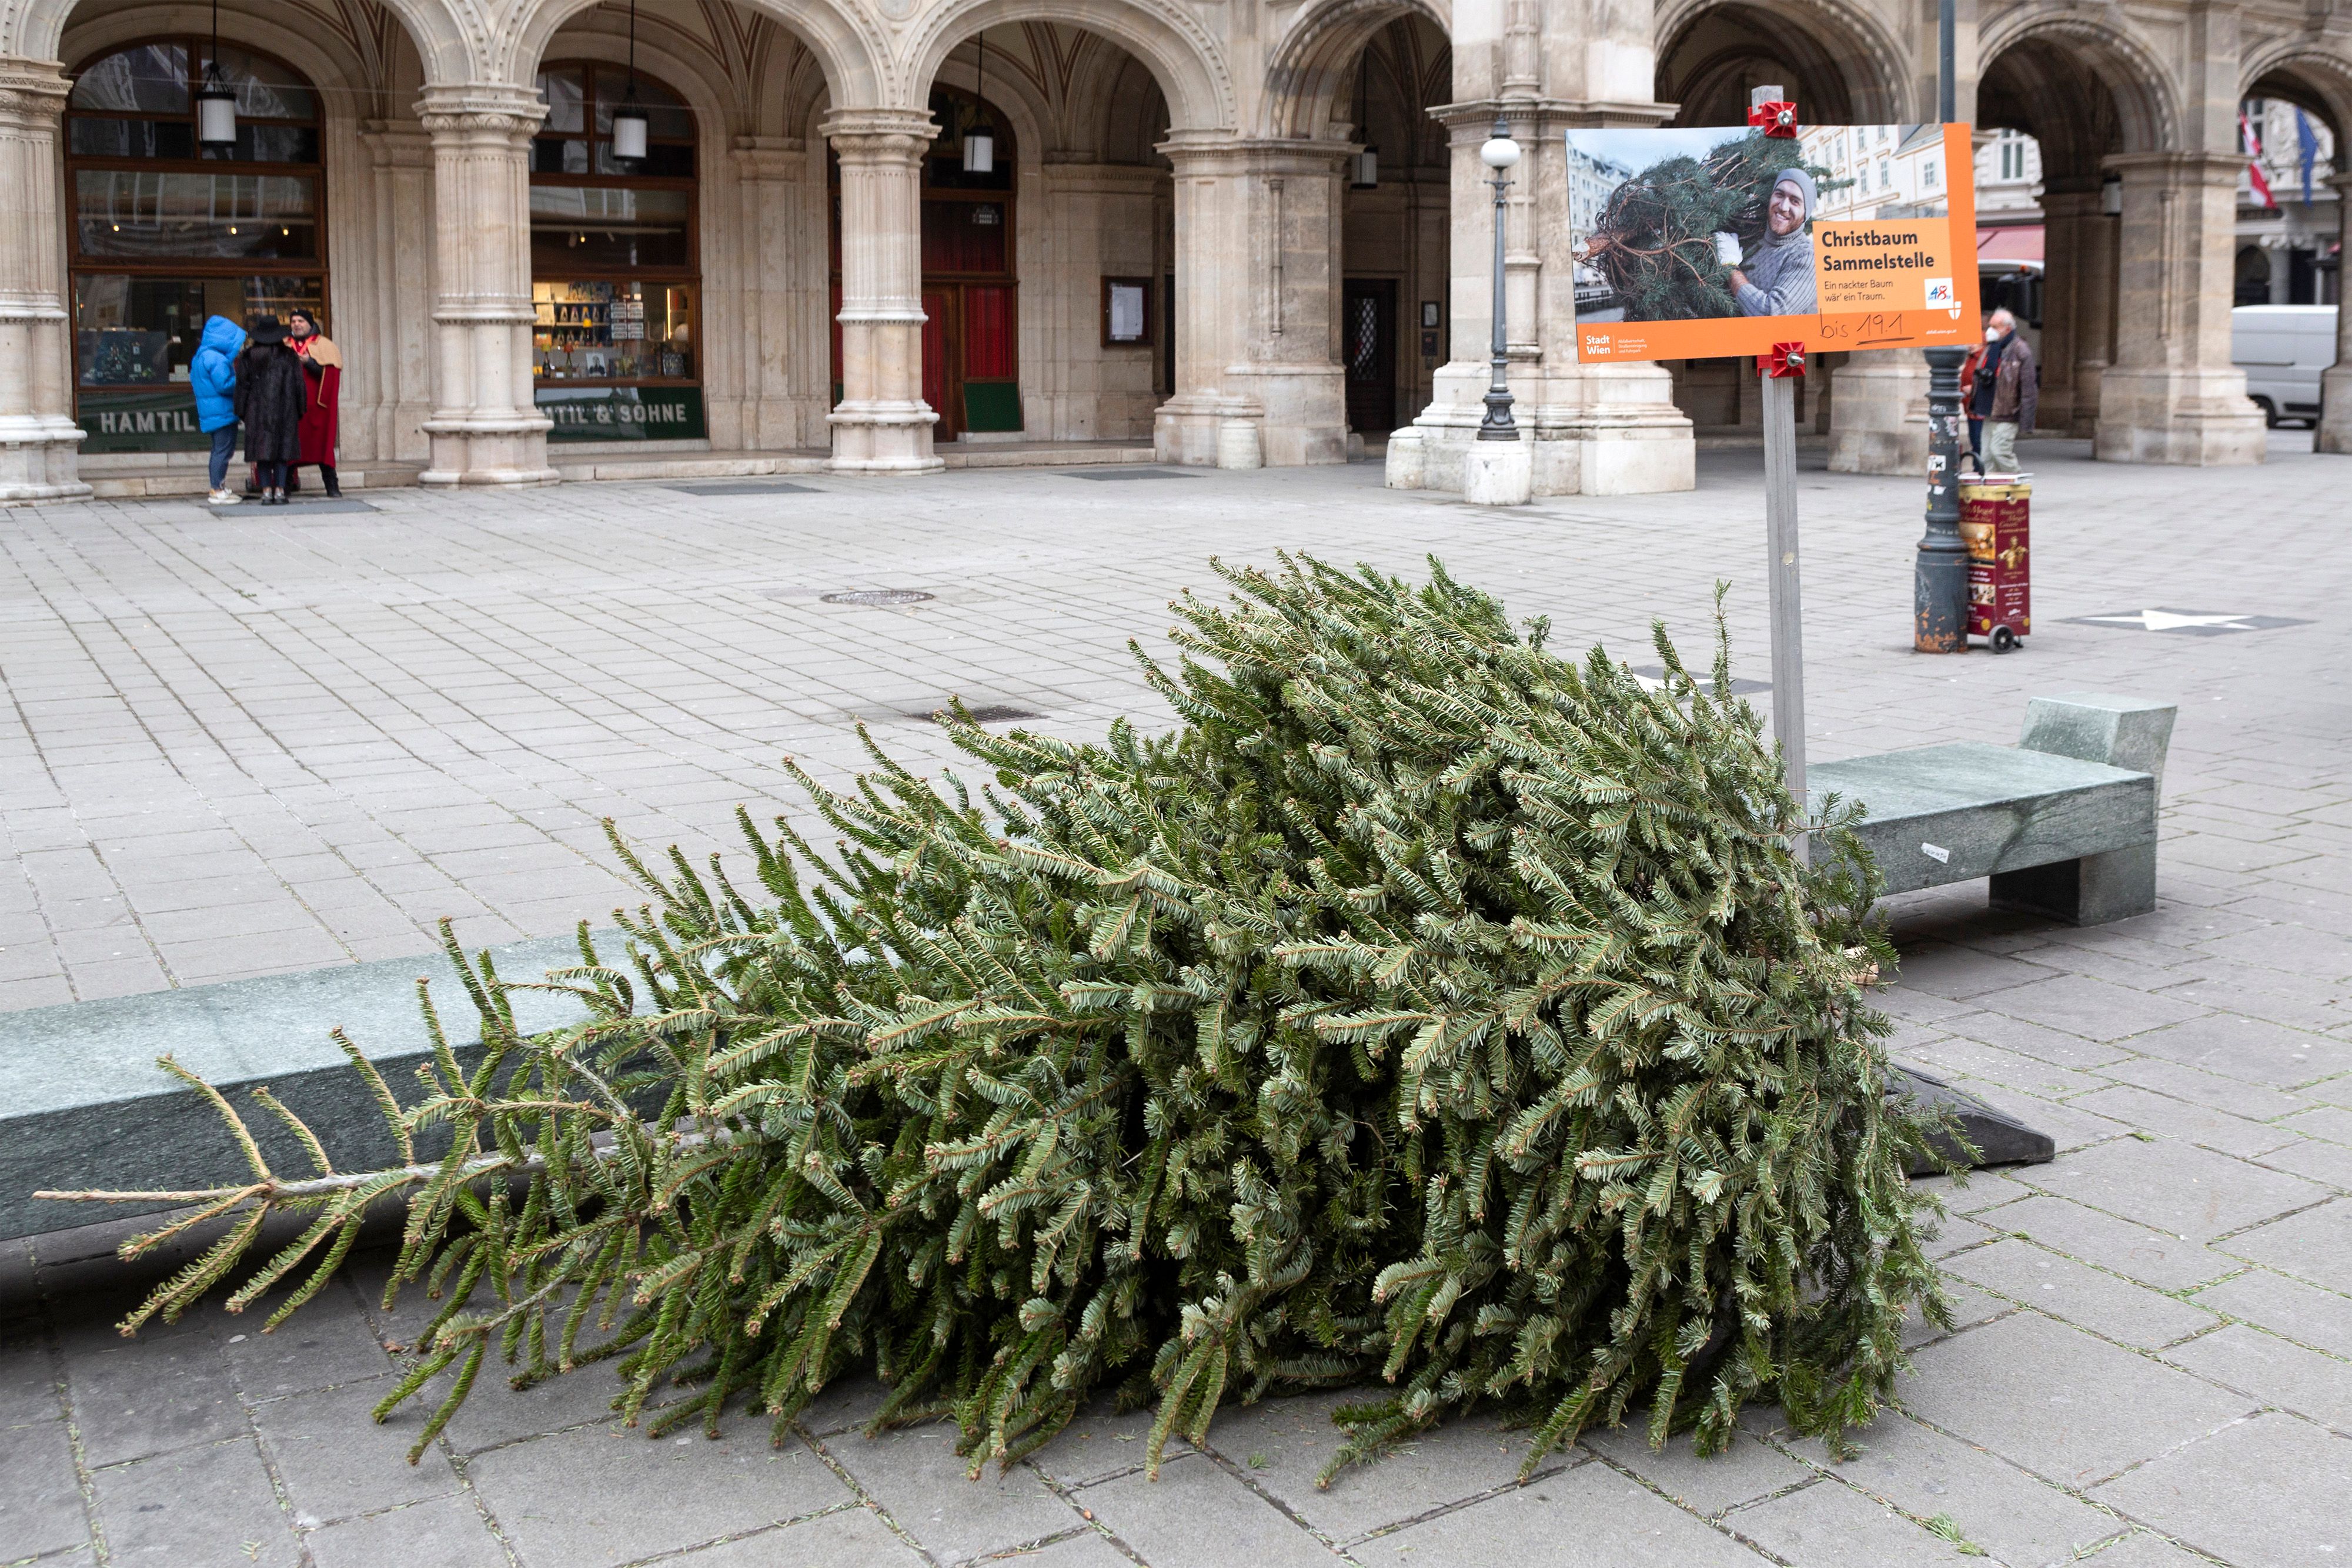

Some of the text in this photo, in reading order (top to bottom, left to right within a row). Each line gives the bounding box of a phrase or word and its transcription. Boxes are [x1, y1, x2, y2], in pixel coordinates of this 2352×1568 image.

[1822, 230, 1918, 248] Christbaum
[1823, 252, 1935, 272] Sammelstelle
[1825, 281, 1836, 290] Ein
[1838, 280, 1868, 289] nackter
[1857, 292, 1885, 300] Traum.
[1820, 308, 1903, 339] bis 19.1
[1586, 335, 1610, 345] Stadt
[1586, 346, 1611, 355] Wien
[101, 411, 196, 433] HAMTIL
[596, 404, 613, 424] &
